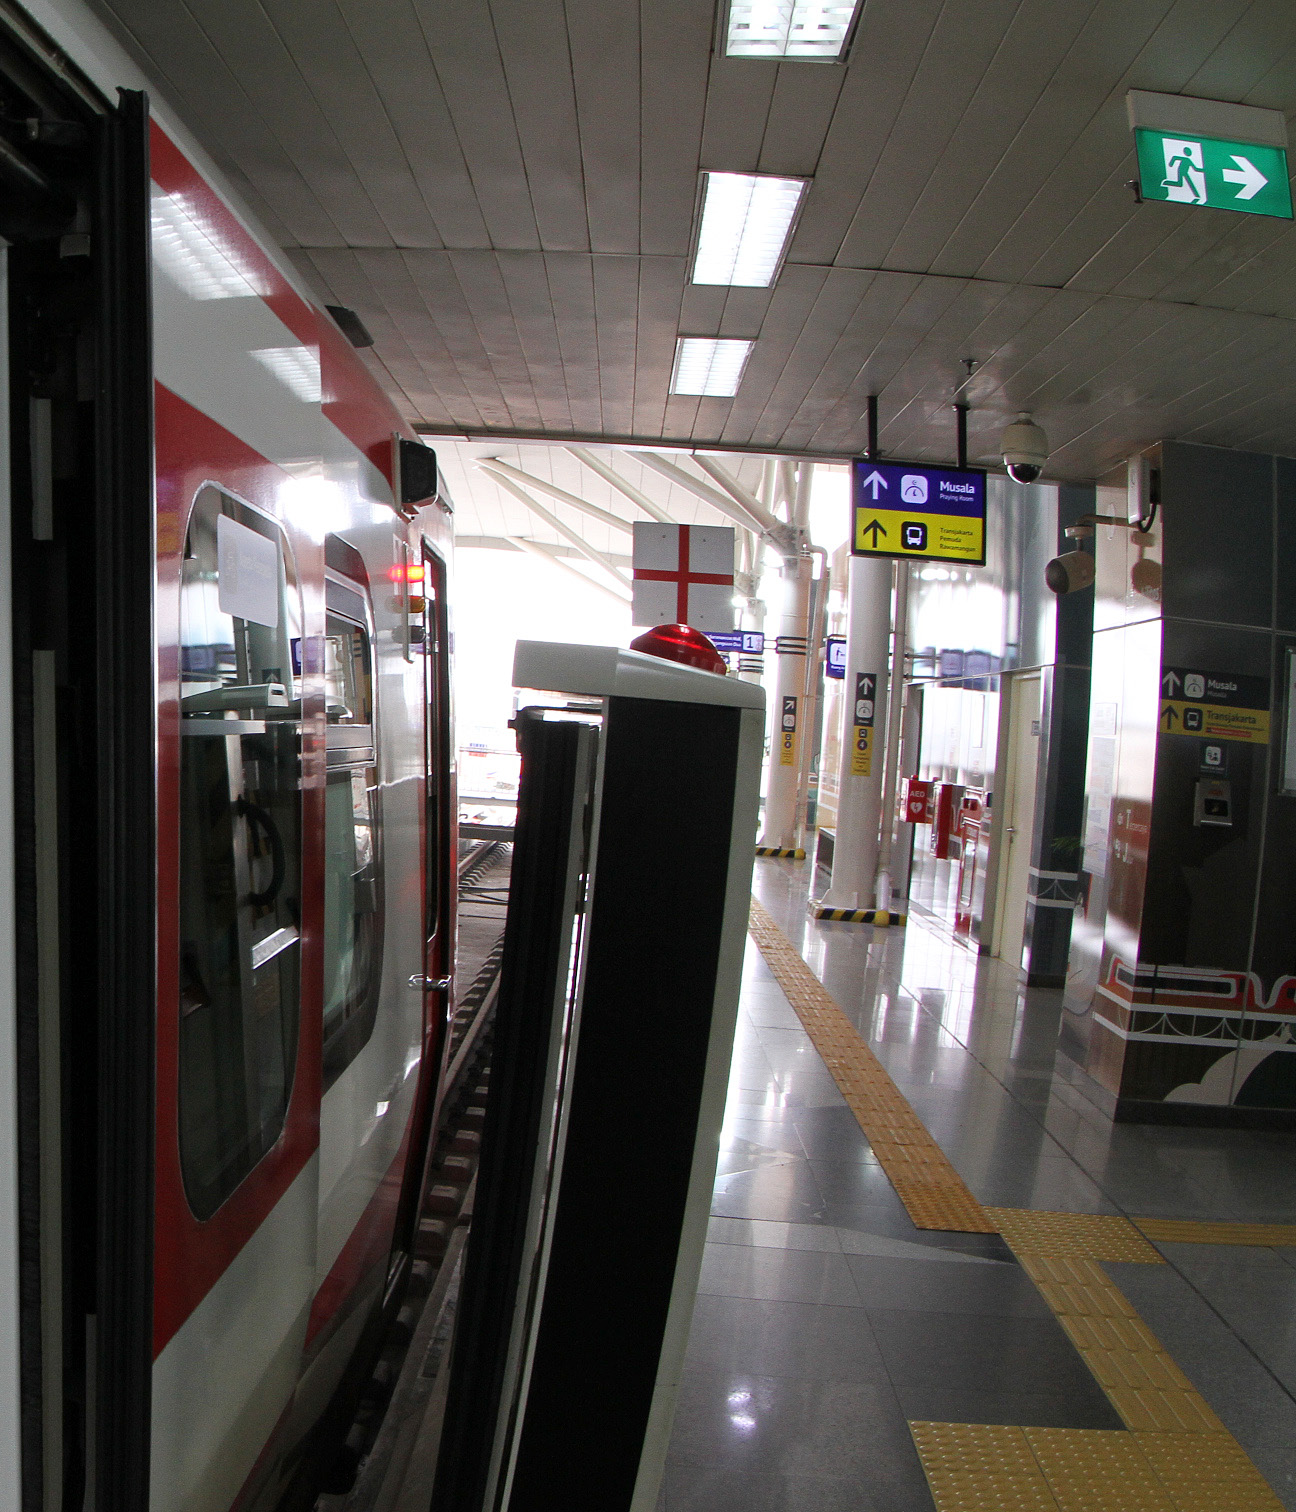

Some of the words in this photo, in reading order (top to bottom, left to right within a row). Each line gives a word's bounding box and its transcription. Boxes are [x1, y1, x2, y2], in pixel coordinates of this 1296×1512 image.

[940, 480, 976, 494] Musala
[746, 636, 754, 648] 1
[1208, 680, 1238, 692] Musala
[1208, 710, 1256, 724] Transjakarta
